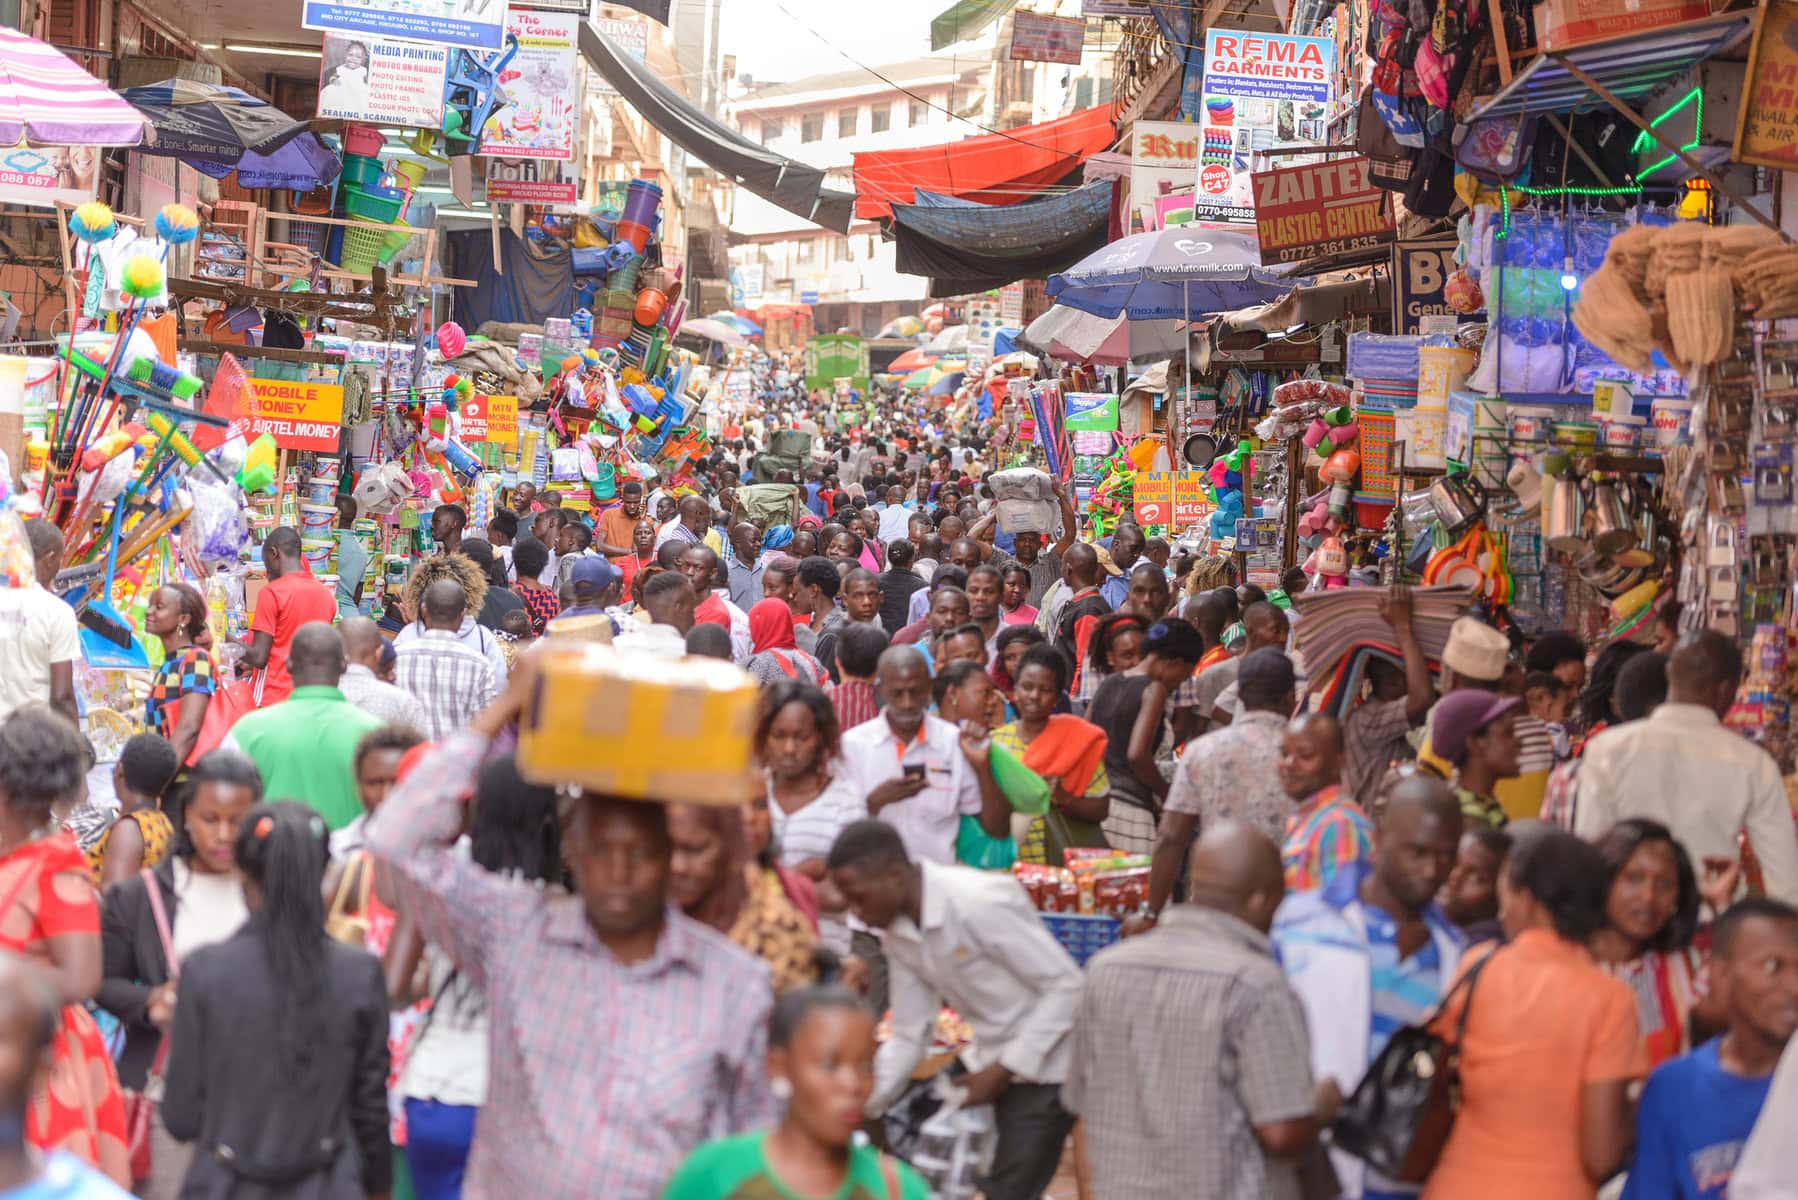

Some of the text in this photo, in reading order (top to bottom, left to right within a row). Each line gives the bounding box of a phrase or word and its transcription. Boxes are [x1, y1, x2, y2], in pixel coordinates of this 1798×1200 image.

[517, 14, 540, 24] The
[525, 25, 569, 37] Corner
[373, 44, 444, 61] MEDIA PRINTING
[1214, 36, 1323, 65] REMA
[371, 71, 394, 80] PHOTO
[1211, 60, 1325, 80] GARMENTS
[370, 81, 393, 90] PHOTO
[369, 91, 397, 101] PLASTIC
[367, 101, 396, 110] COLOUR
[399, 104, 420, 112] PHOTO
[363, 111, 407, 123] SCANNING
[0, 172, 24, 184] 088
[1202, 171, 1227, 181] Shop
[1204, 179, 1229, 191] C47
[1197, 205, 1256, 218] 0770-695858
[1325, 202, 1386, 240] CENTRE
[1259, 212, 1323, 249] PLASTIC
[1279, 235, 1378, 262] 0772 361 835
[1152, 262, 1244, 273] www.latomilk.com
[252, 384, 318, 401] MOBILE
[250, 399, 307, 415] MONEY
[492, 404, 512, 412] MTN
[488, 413, 517, 422] MOBILE
[252, 420, 341, 439] AIRTEL MONEY
[488, 422, 517, 432] MONEY
[1134, 481, 1168, 493] MOBILE
[1175, 501, 1206, 515] airtel
